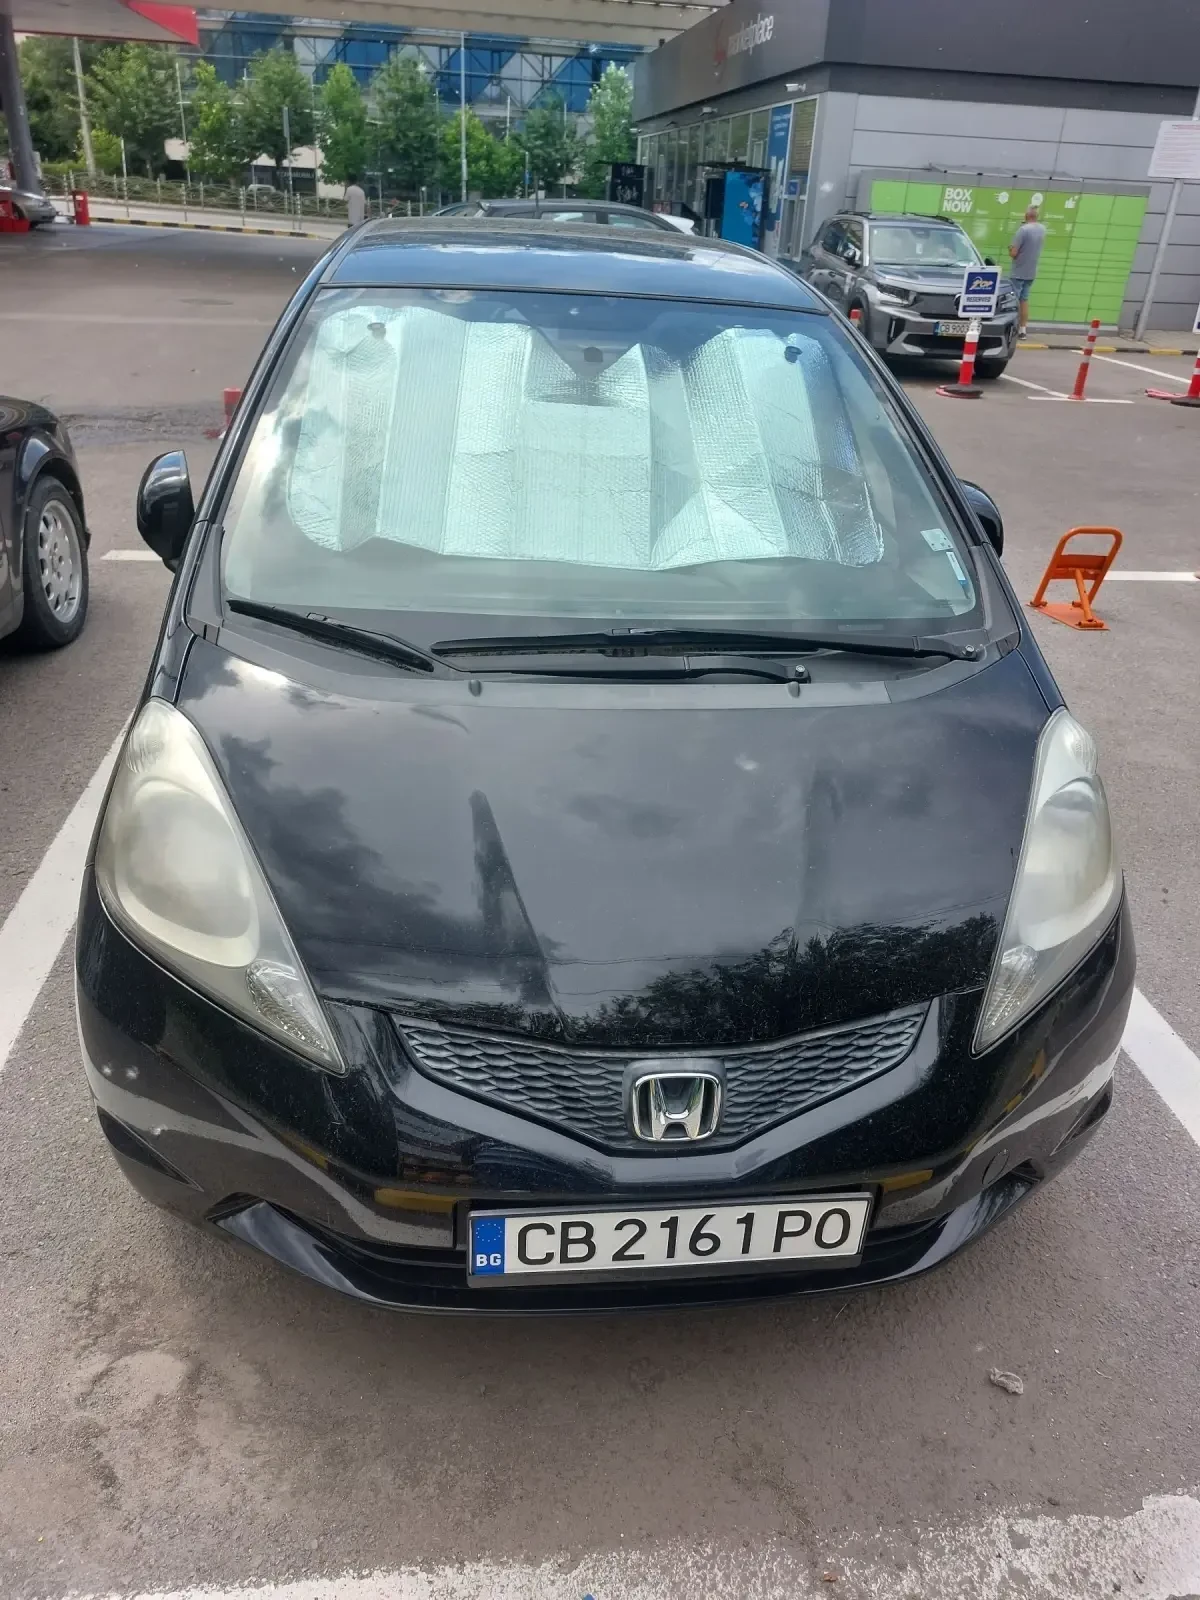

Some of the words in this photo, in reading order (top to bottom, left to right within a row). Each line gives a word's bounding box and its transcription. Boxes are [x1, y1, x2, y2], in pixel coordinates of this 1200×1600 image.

[944, 187, 972, 200] BOX
[942, 200, 973, 213] NOW
[517, 1220, 597, 1266] CB
[611, 1212, 757, 1262] 2161
[772, 1207, 851, 1253] PO
[476, 1253, 502, 1267] BG
